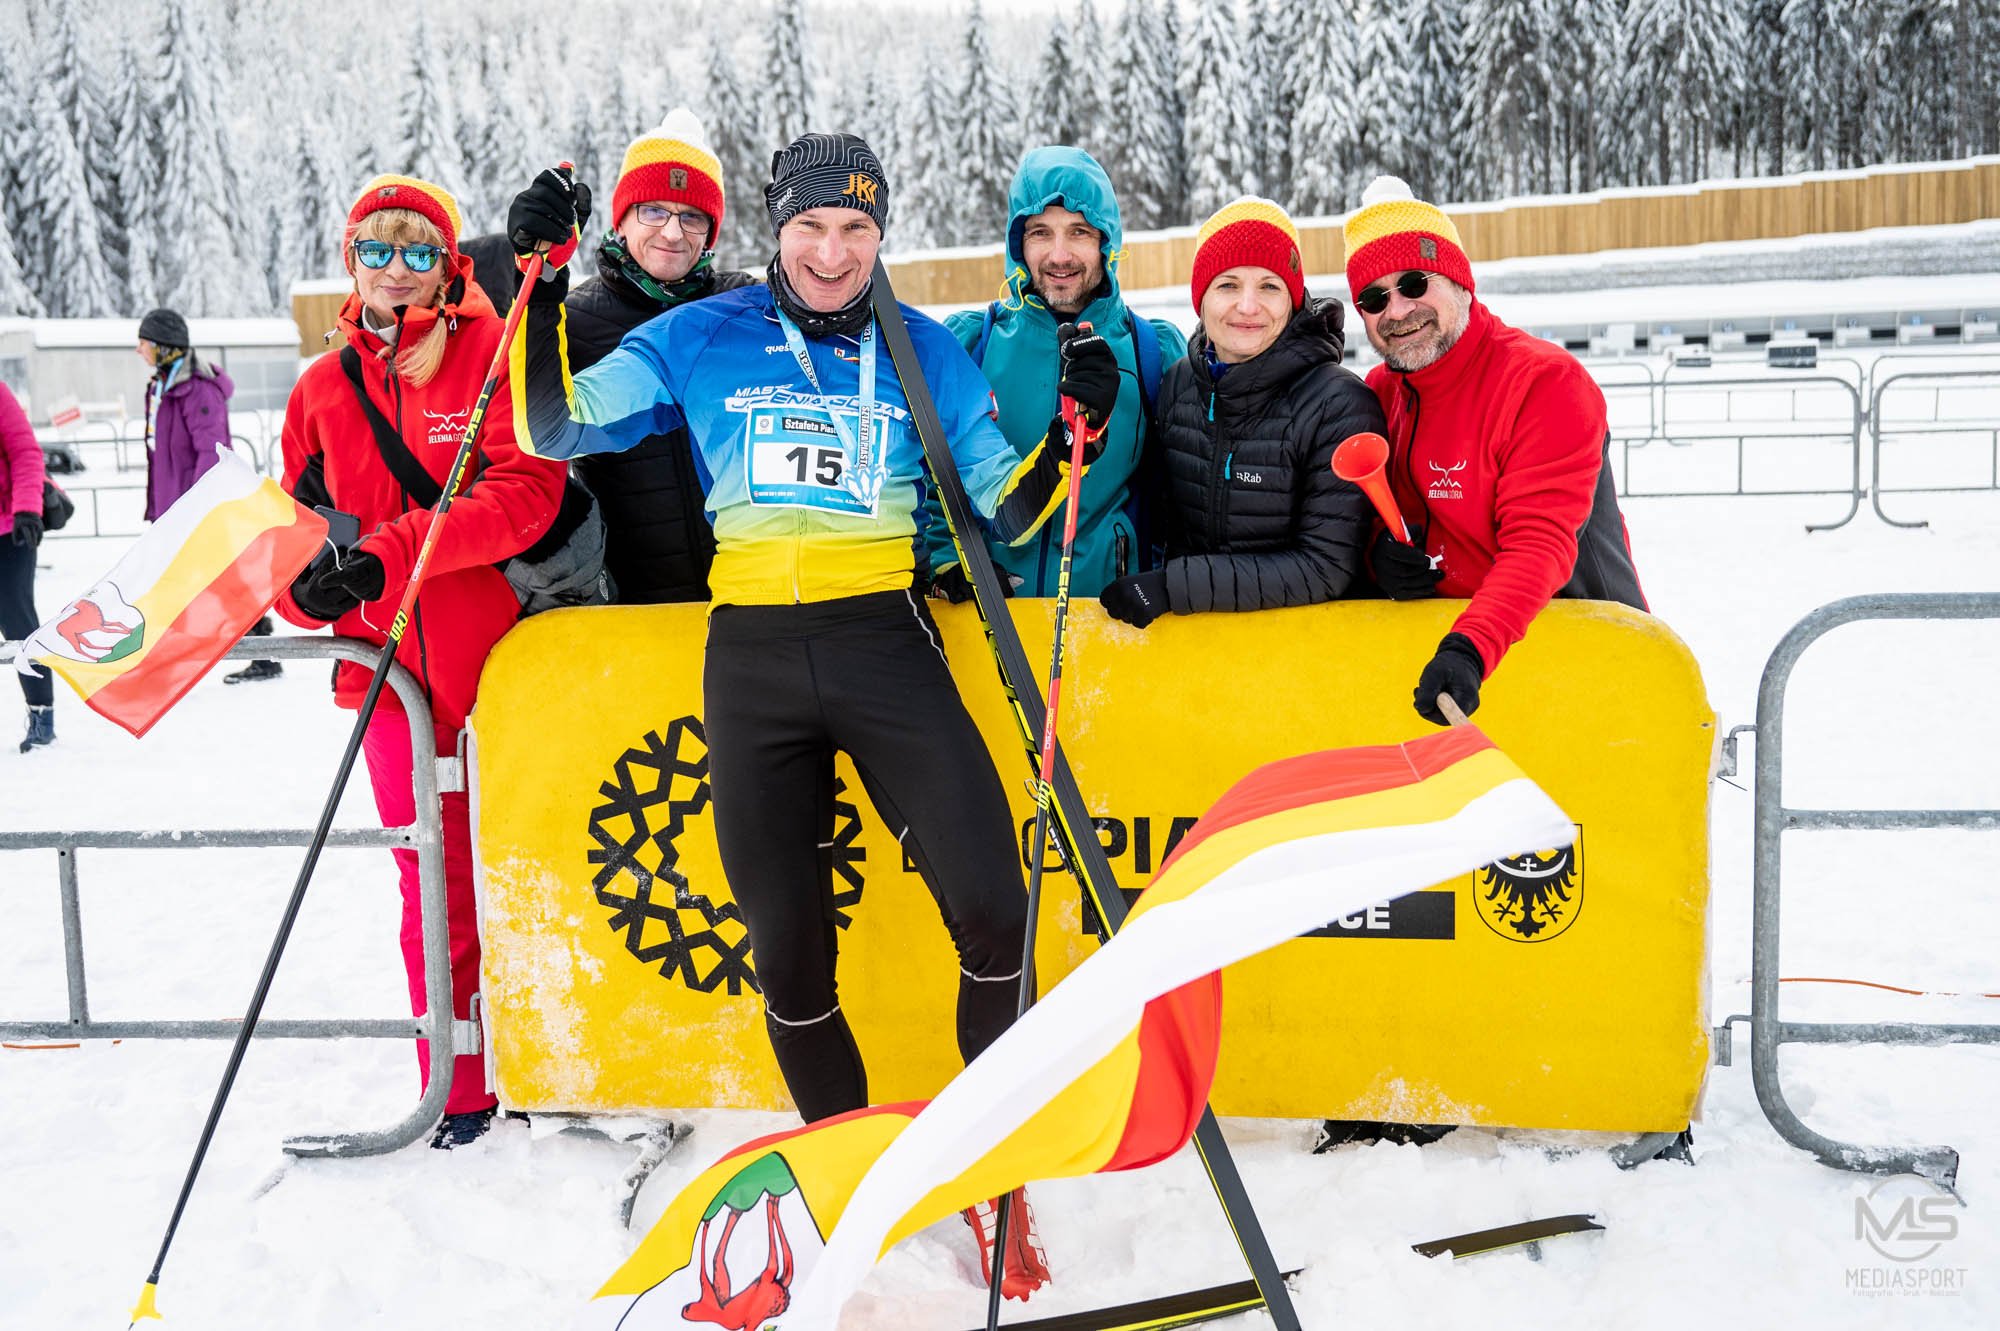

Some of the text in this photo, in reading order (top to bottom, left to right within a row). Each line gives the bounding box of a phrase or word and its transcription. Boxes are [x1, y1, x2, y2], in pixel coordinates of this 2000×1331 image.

[765, 342, 791, 355] ques
[463, 393, 489, 444] LEKI
[784, 418, 838, 434] Sztafeta Piast
[428, 434, 453, 444] JELENIA
[785, 446, 844, 487] 15
[1243, 471, 1262, 484] Rab
[1428, 489, 1449, 499] JELENIA
[1056, 556, 1071, 607] LEKI
[1133, 583, 1150, 606] FORCLAZ
